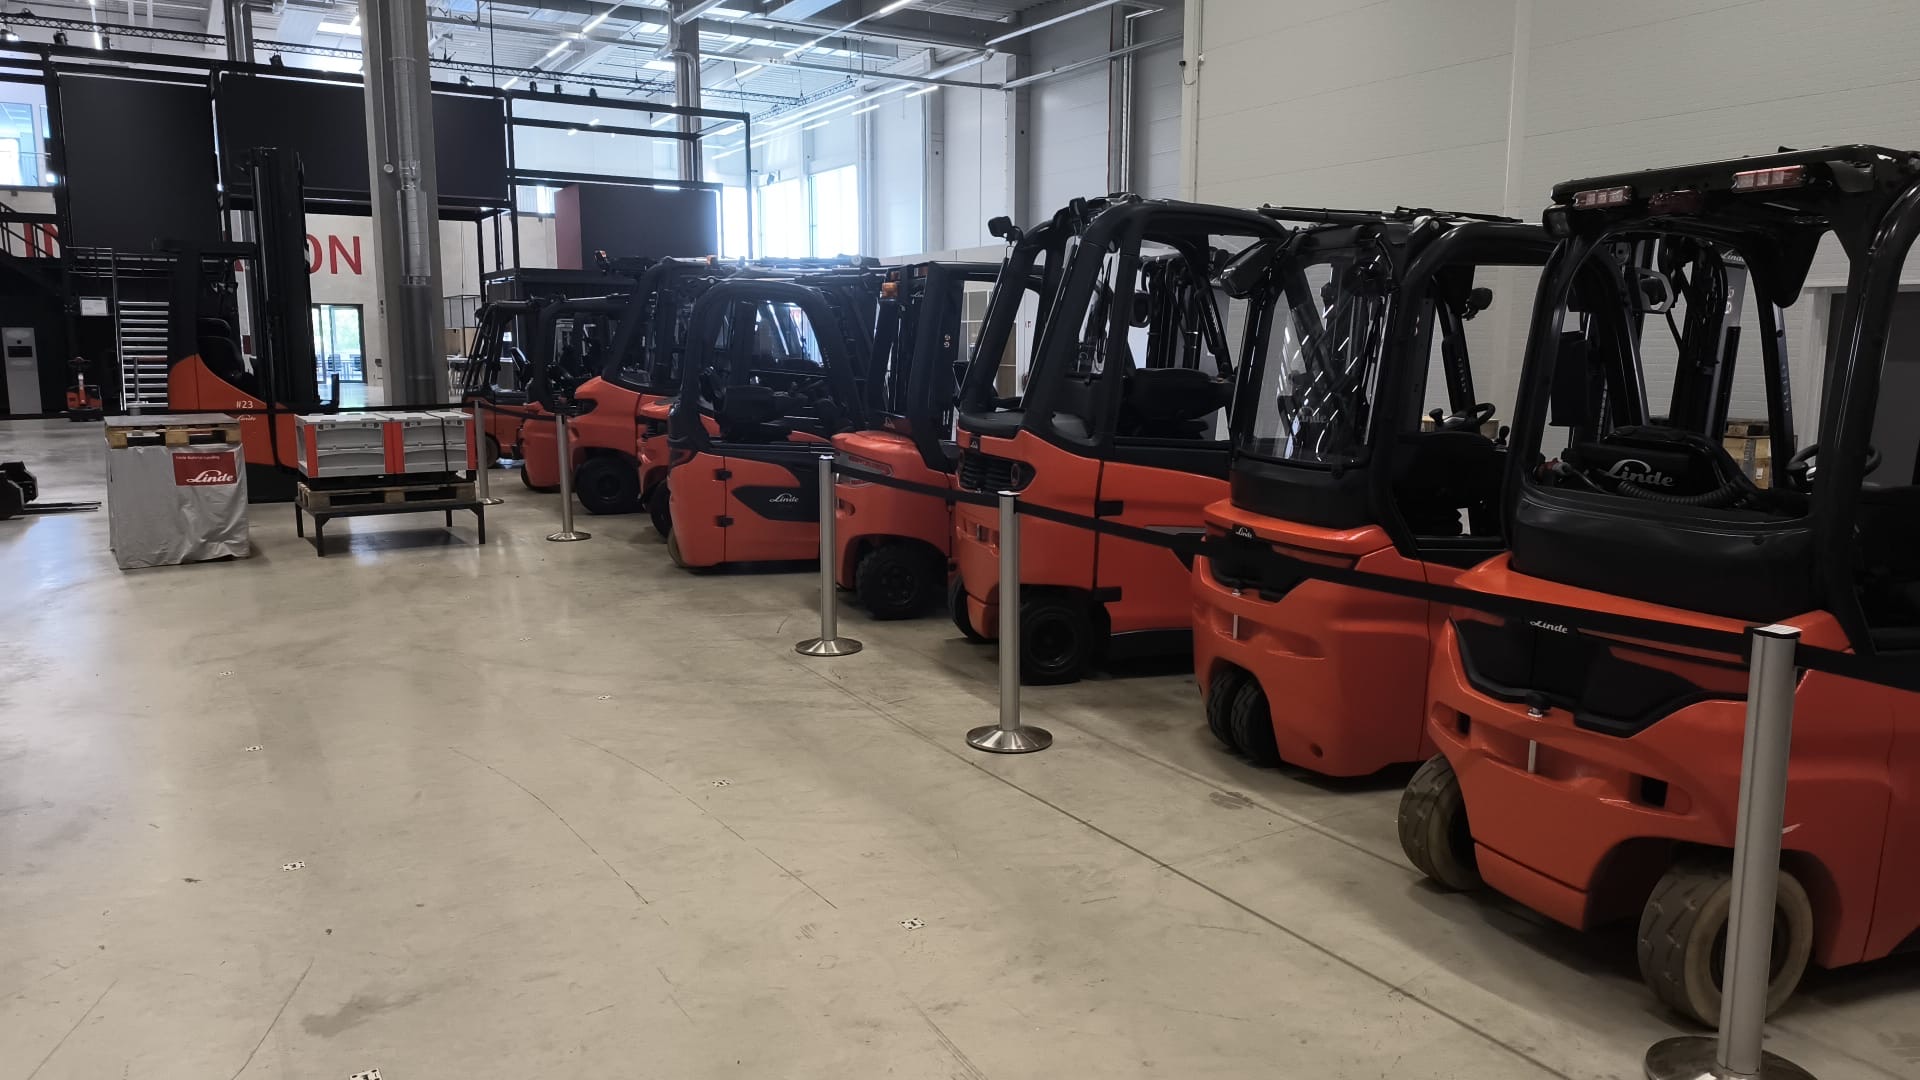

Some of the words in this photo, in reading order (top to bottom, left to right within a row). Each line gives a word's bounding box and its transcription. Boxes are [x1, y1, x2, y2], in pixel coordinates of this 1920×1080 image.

[186, 469, 234, 483] Linde
[1596, 458, 1674, 487] Linde
[768, 492, 800, 503] Linde
[1529, 620, 1569, 634] Linde
